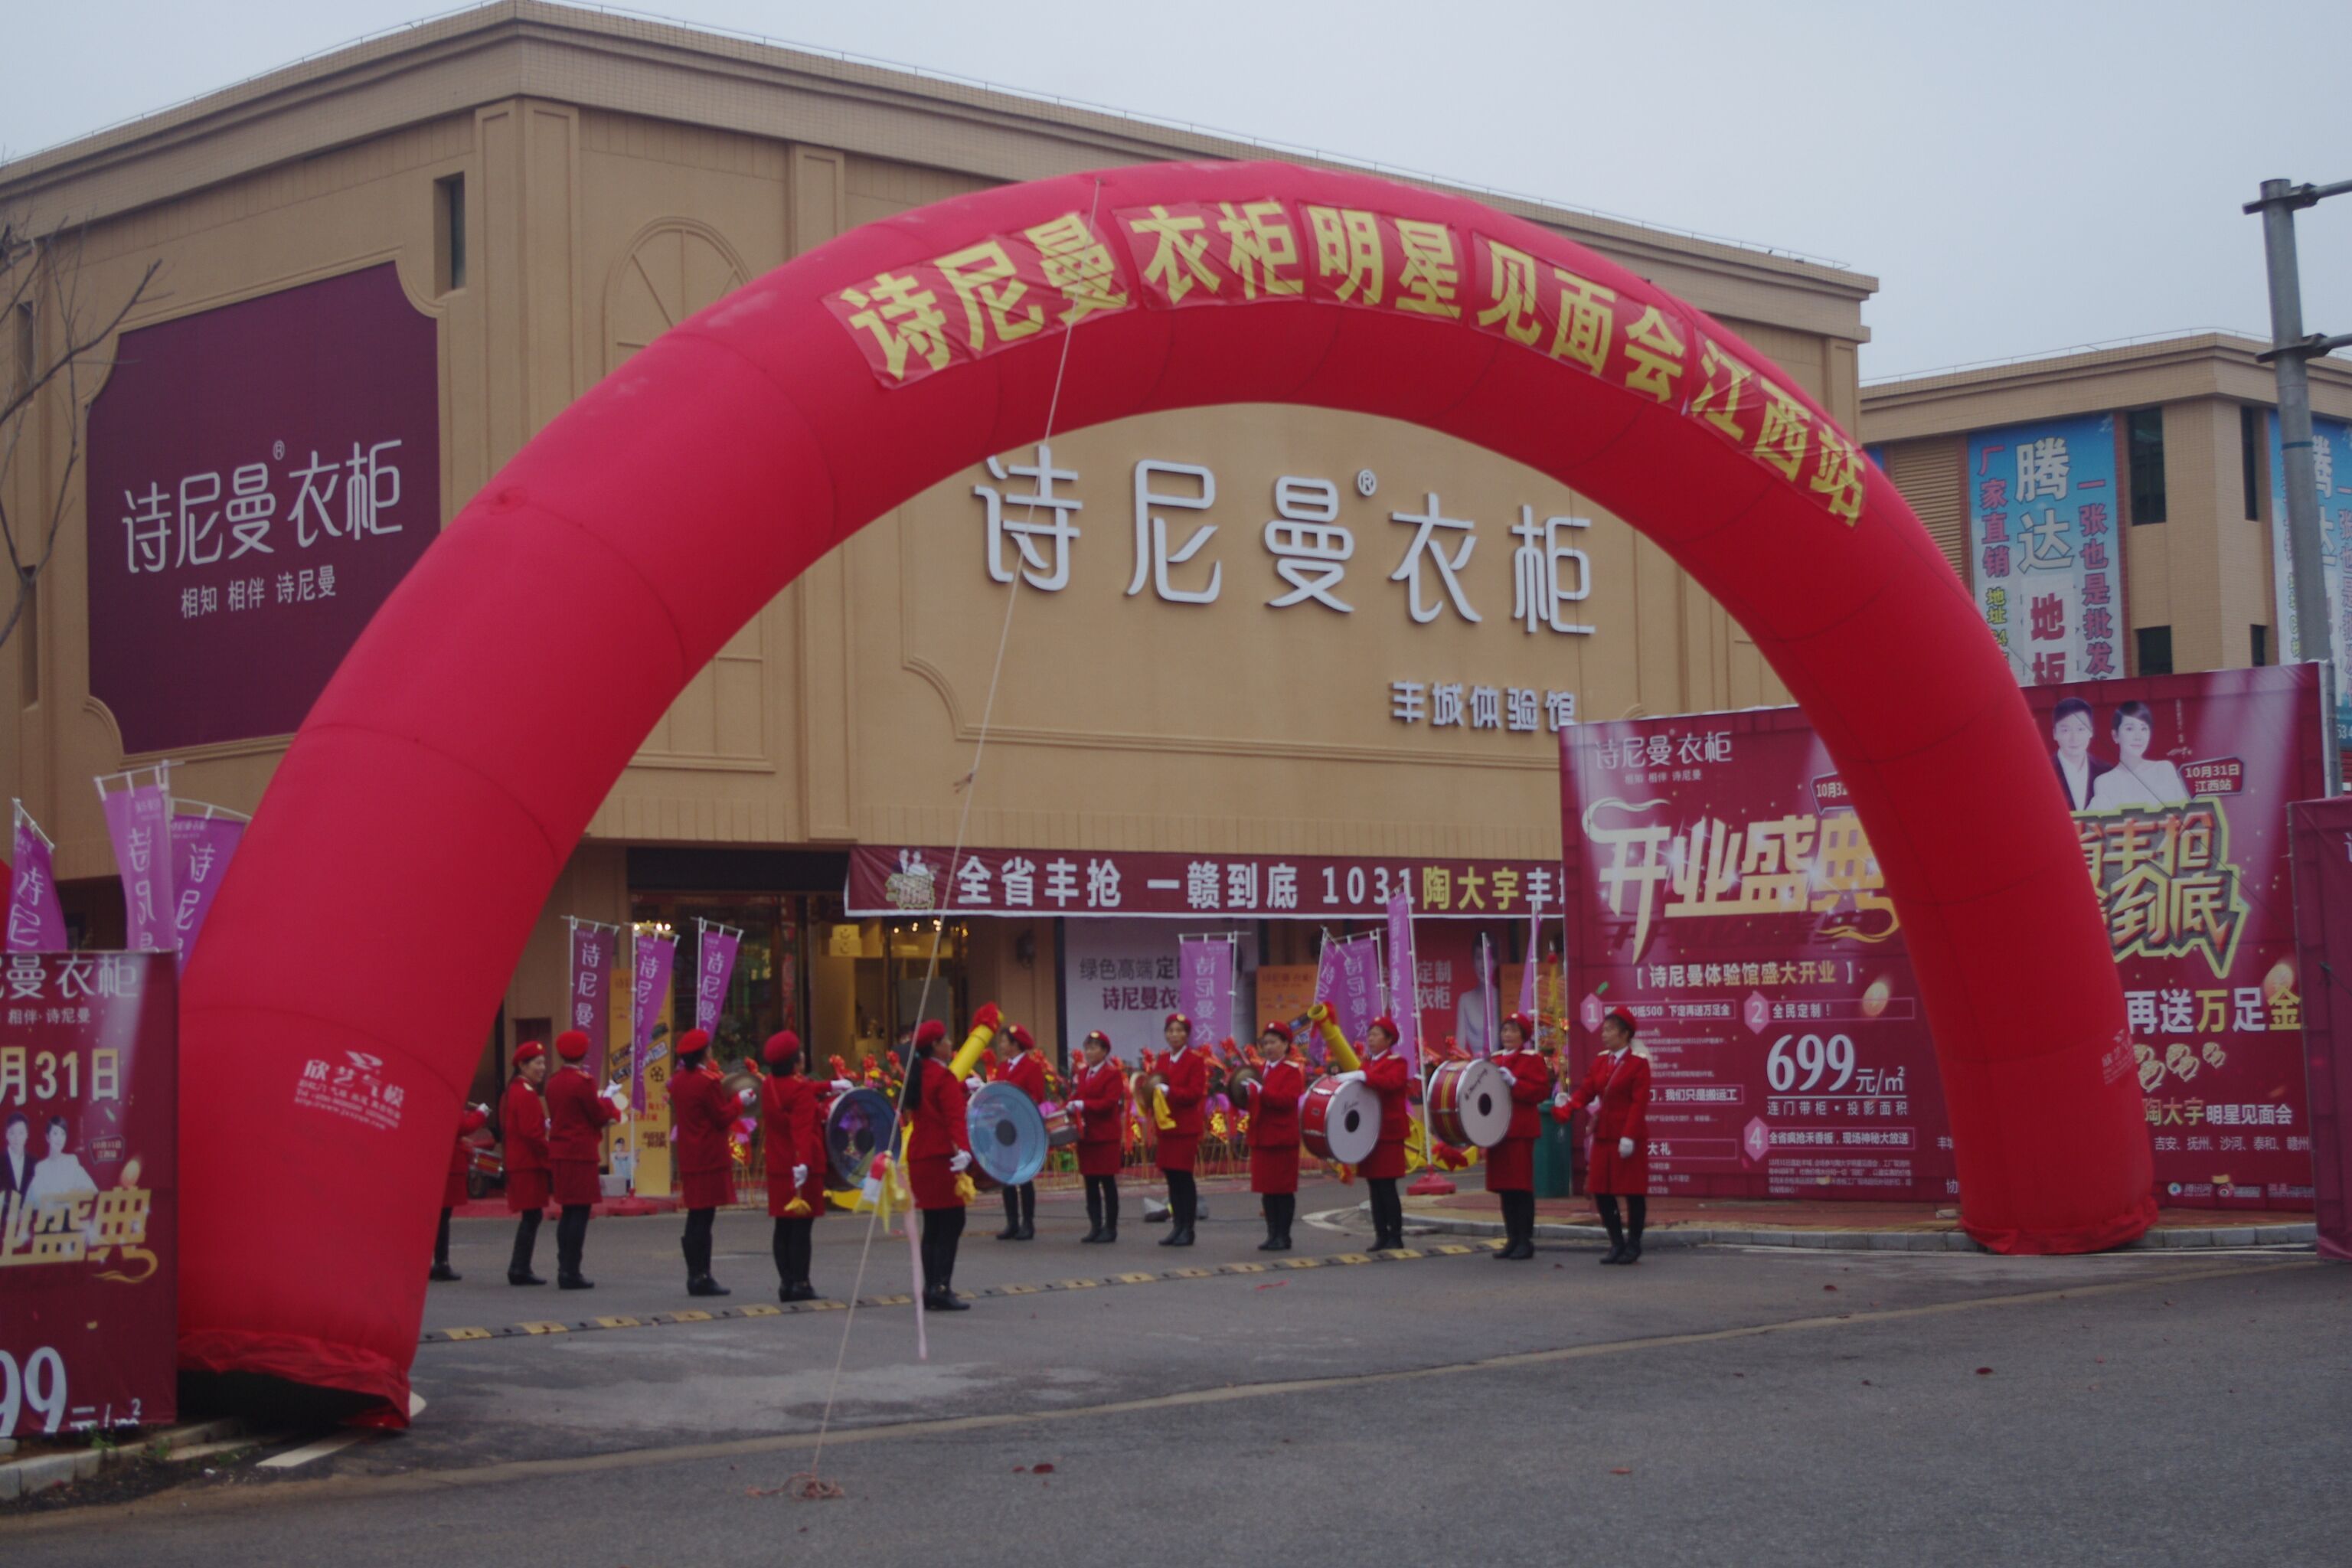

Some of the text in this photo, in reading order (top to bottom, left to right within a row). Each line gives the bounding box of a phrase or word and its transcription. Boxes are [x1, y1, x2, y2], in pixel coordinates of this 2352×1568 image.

[1978, 444, 2011, 579] 厂家直销
[2015, 436, 2075, 576] 腾达
[181, 564, 337, 619] 相知 相伴 诗尼曼
[2077, 479, 2115, 681] 一张也是批发
[1391, 679, 1577, 733] 丰城体验馆
[1592, 730, 1734, 770] 诗尼曼衣柜
[2185, 764, 2239, 779] 10月31日
[2194, 779, 2232, 793] 江西站
[956, 856, 1122, 908] 全省丰抢
[1146, 861, 1298, 910] 一赣到底
[1321, 865, 1564, 912] 1031陶大宇丰
[1582, 796, 1902, 965] 开业盛典
[2096, 863, 2230, 953] 到底
[0, 955, 139, 1000] 曼衣柜
[1080, 955, 1181, 981] 绿色高端定
[1102, 985, 1180, 1010] 诗尼曼衣
[1587, 1003, 1599, 1024] 1
[1751, 1001, 1763, 1024] 2
[2124, 986, 2301, 1034] 再送万足金
[2143, 1096, 2294, 1127] 陶大宇明星见面会
[1749, 1128, 1762, 1150] 4
